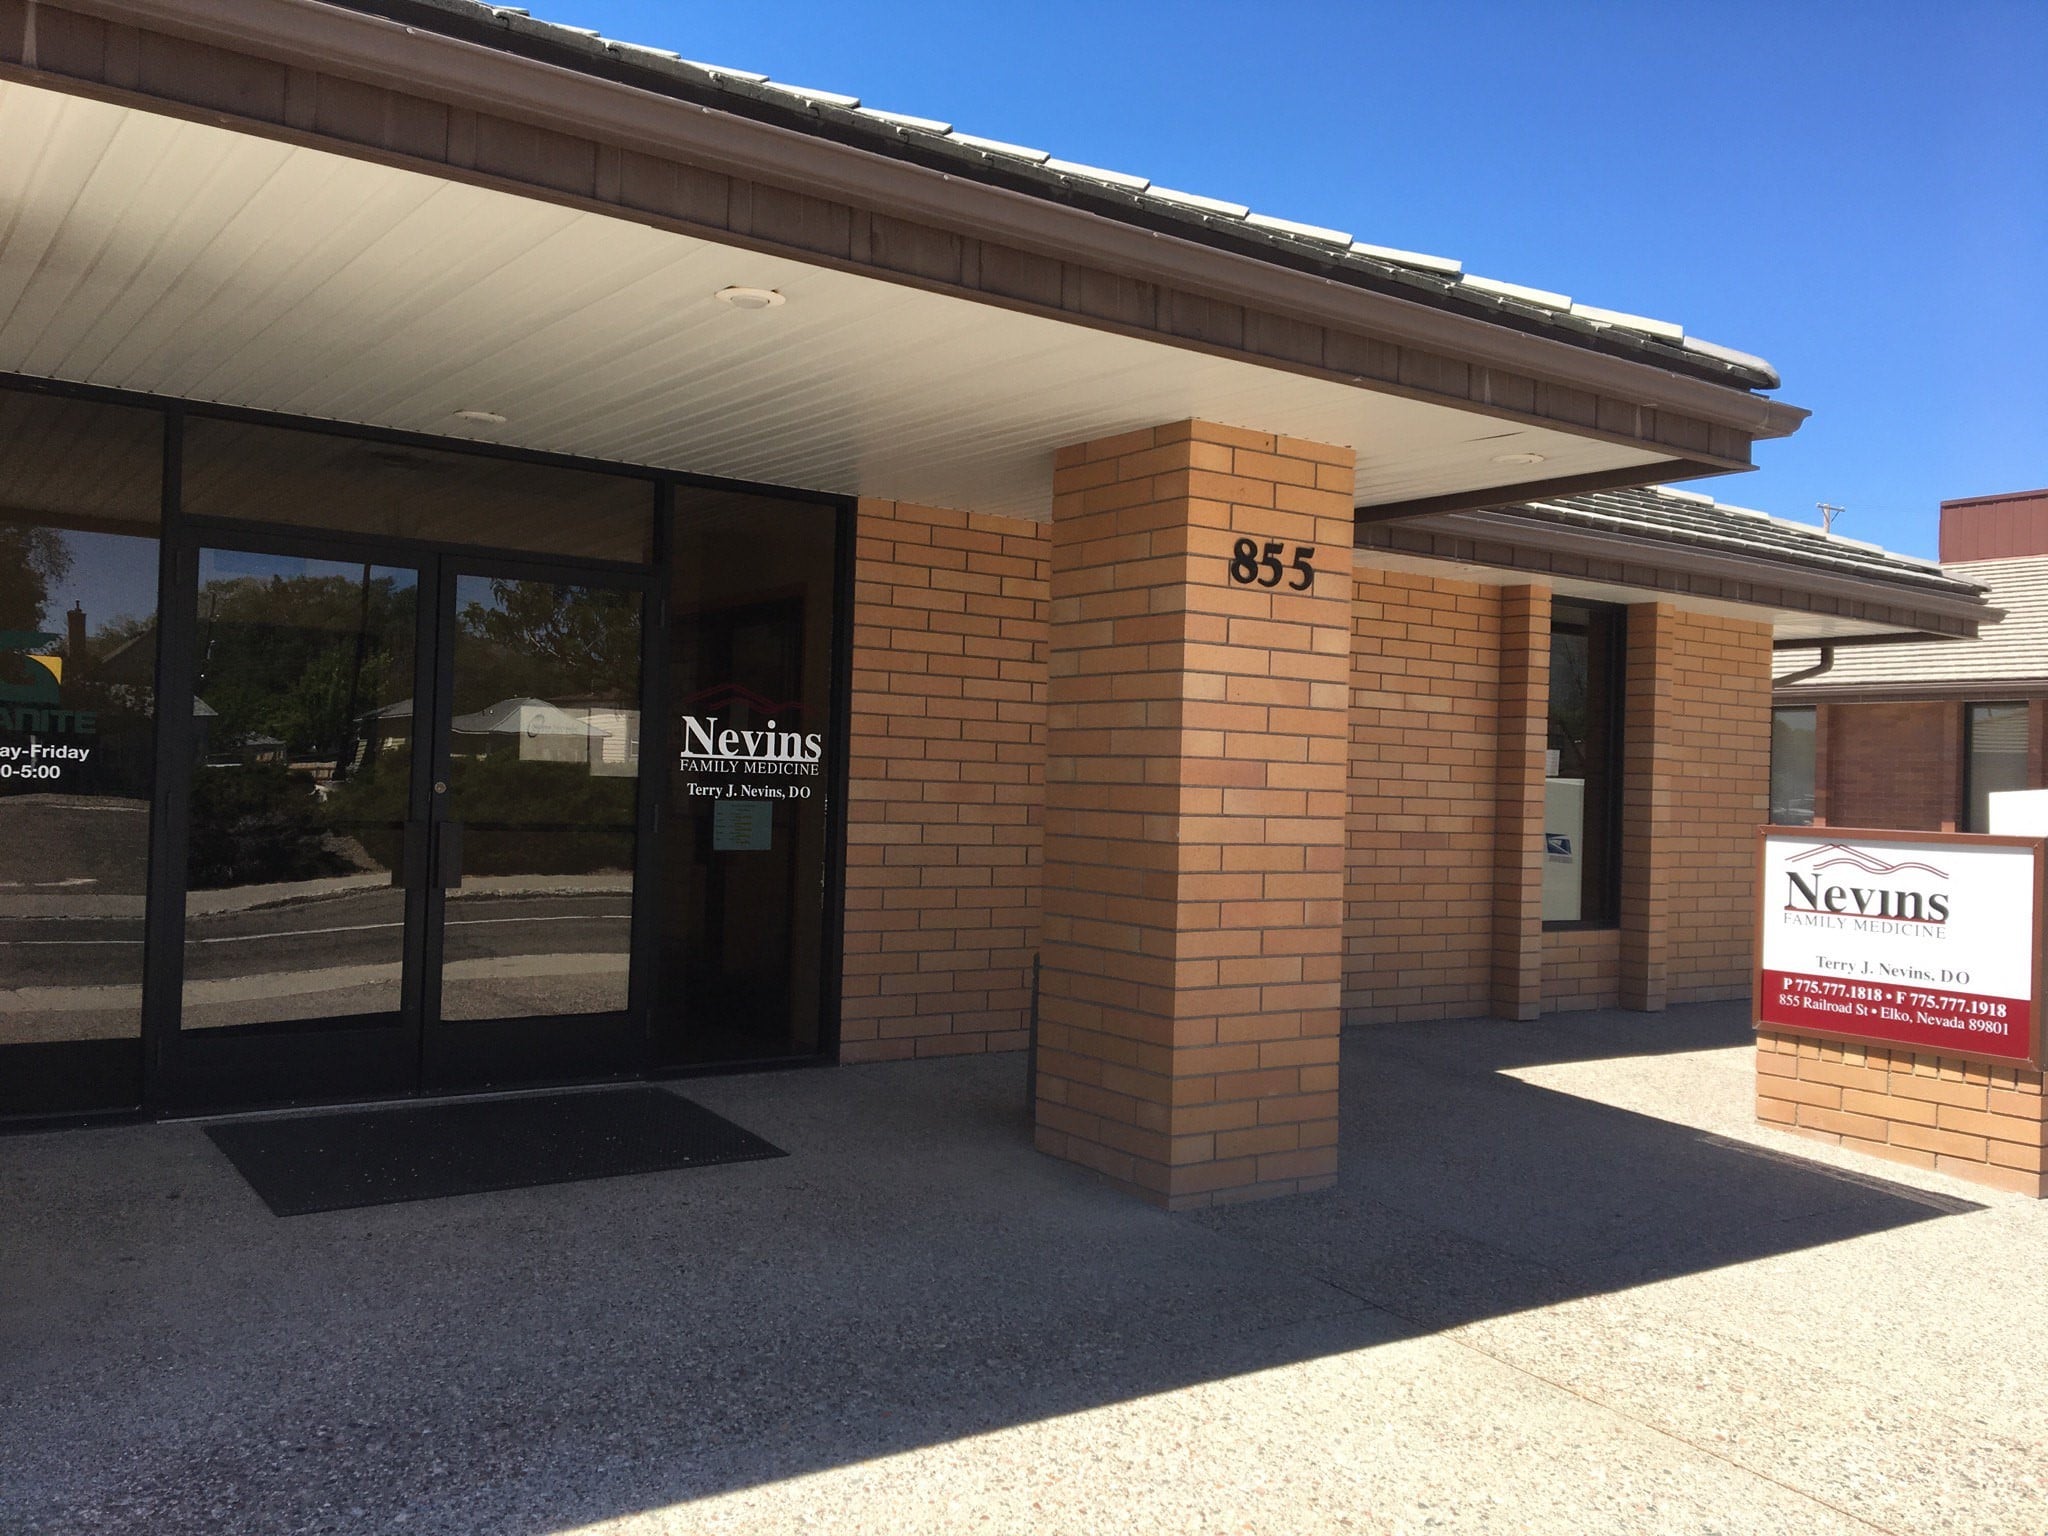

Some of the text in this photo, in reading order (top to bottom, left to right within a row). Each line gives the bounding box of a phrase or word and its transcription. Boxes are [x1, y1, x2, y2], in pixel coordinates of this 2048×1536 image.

[1231, 537, 1315, 591] 855
[680, 715, 822, 762] Nevins
[680, 759, 819, 776] FAMILY MEDICINE
[687, 782, 811, 800] Terry J. Nevins, DO
[1784, 871, 1950, 924] Nevins
[1783, 912, 1947, 940] FAMILY MEDICINE
[1816, 955, 1857, 975] Terry
[1860, 961, 1874, 975] J.
[1941, 969, 1970, 985] DO
[1779, 994, 2009, 1036] 855 Railroad St Elko, Nevada 89801
[1783, 977, 2007, 1018] P 775.777.1818 F 775.777.1918
